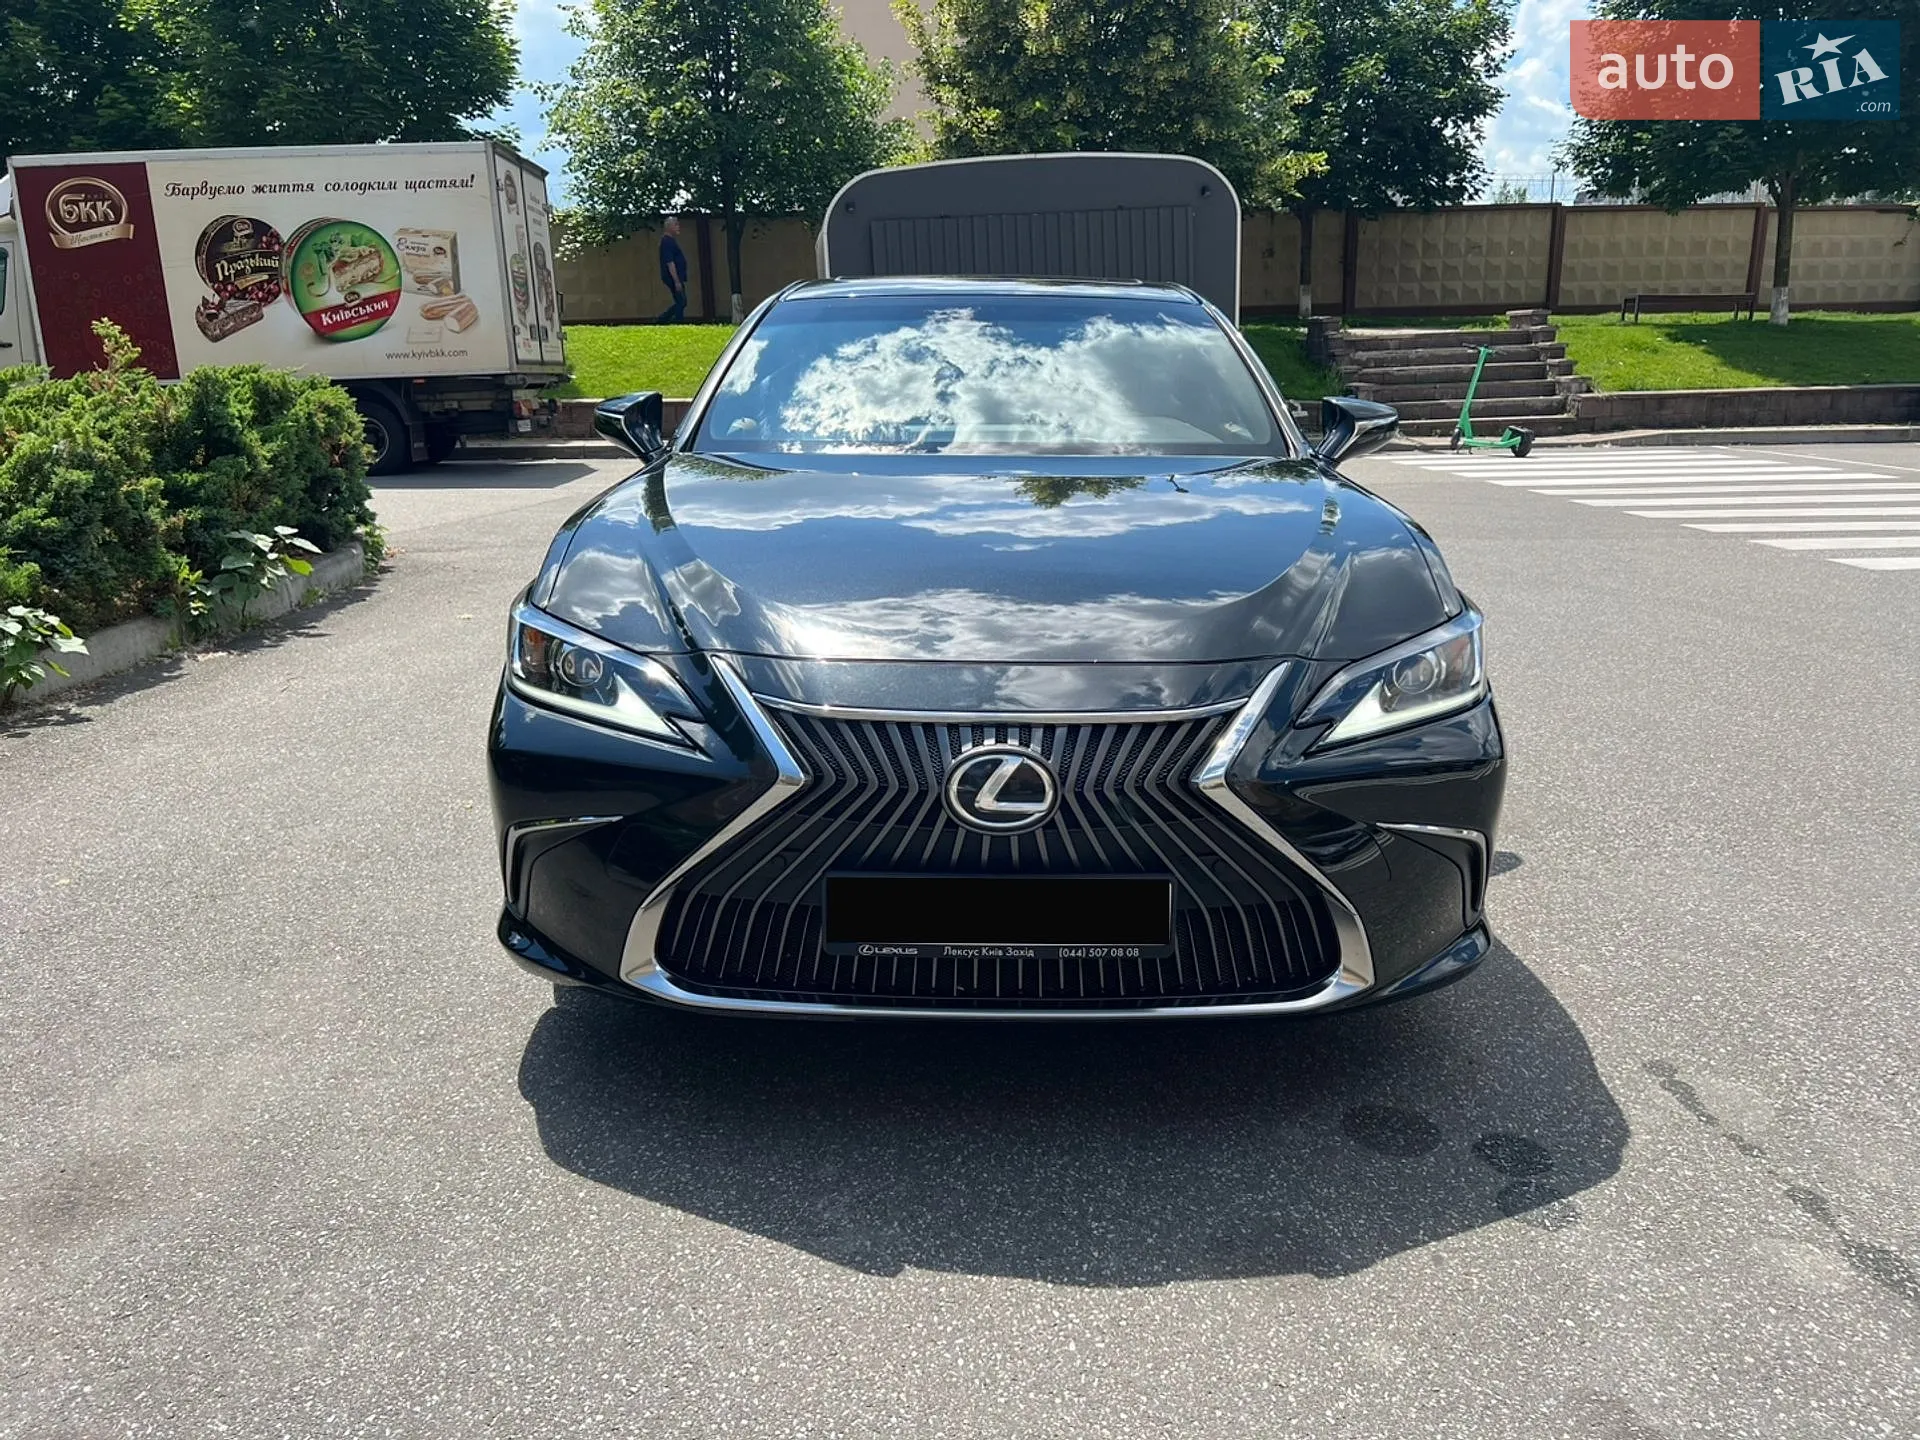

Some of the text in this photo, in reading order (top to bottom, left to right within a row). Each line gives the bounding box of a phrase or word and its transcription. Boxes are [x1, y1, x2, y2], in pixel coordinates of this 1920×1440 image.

[164, 173, 475, 200] Барвуємо життя солодким щастям!
[385, 348, 469, 360] www.kyivbkk.com
[875, 946, 919, 955] LEXUS
[944, 945, 980, 958] Лексус
[1059, 946, 1140, 958] (044) 507 08 08
